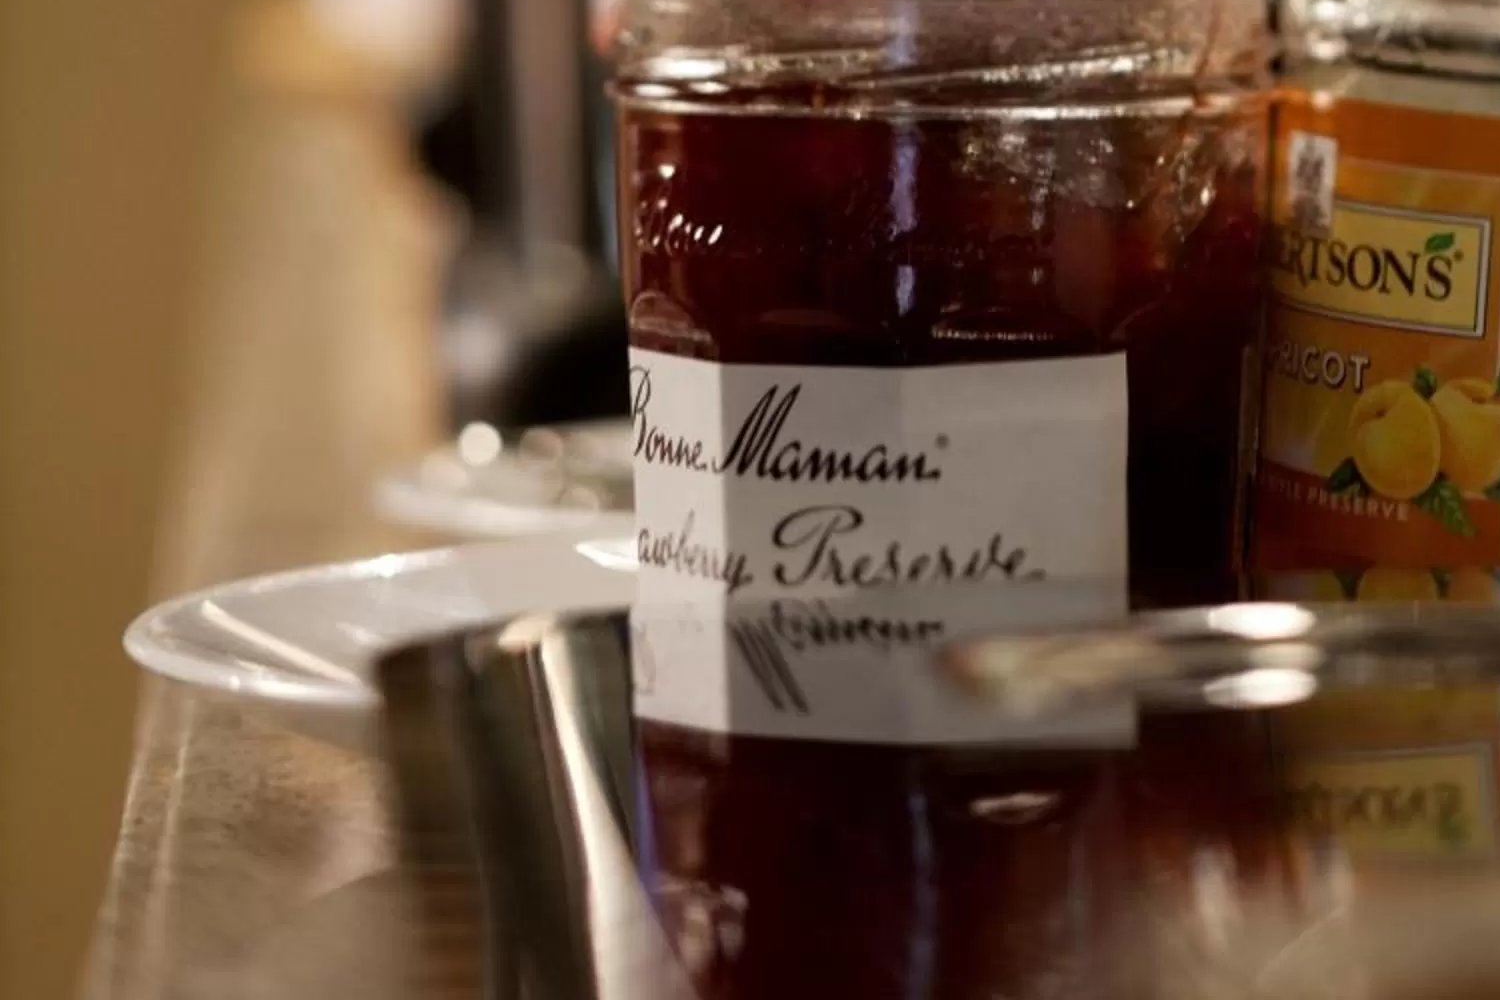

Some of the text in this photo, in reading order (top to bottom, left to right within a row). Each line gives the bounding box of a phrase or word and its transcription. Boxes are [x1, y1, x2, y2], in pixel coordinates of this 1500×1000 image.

[1278, 341, 1370, 393] RICOT
[712, 382, 941, 484] Maman
[637, 504, 1047, 595] awberry Preserve
